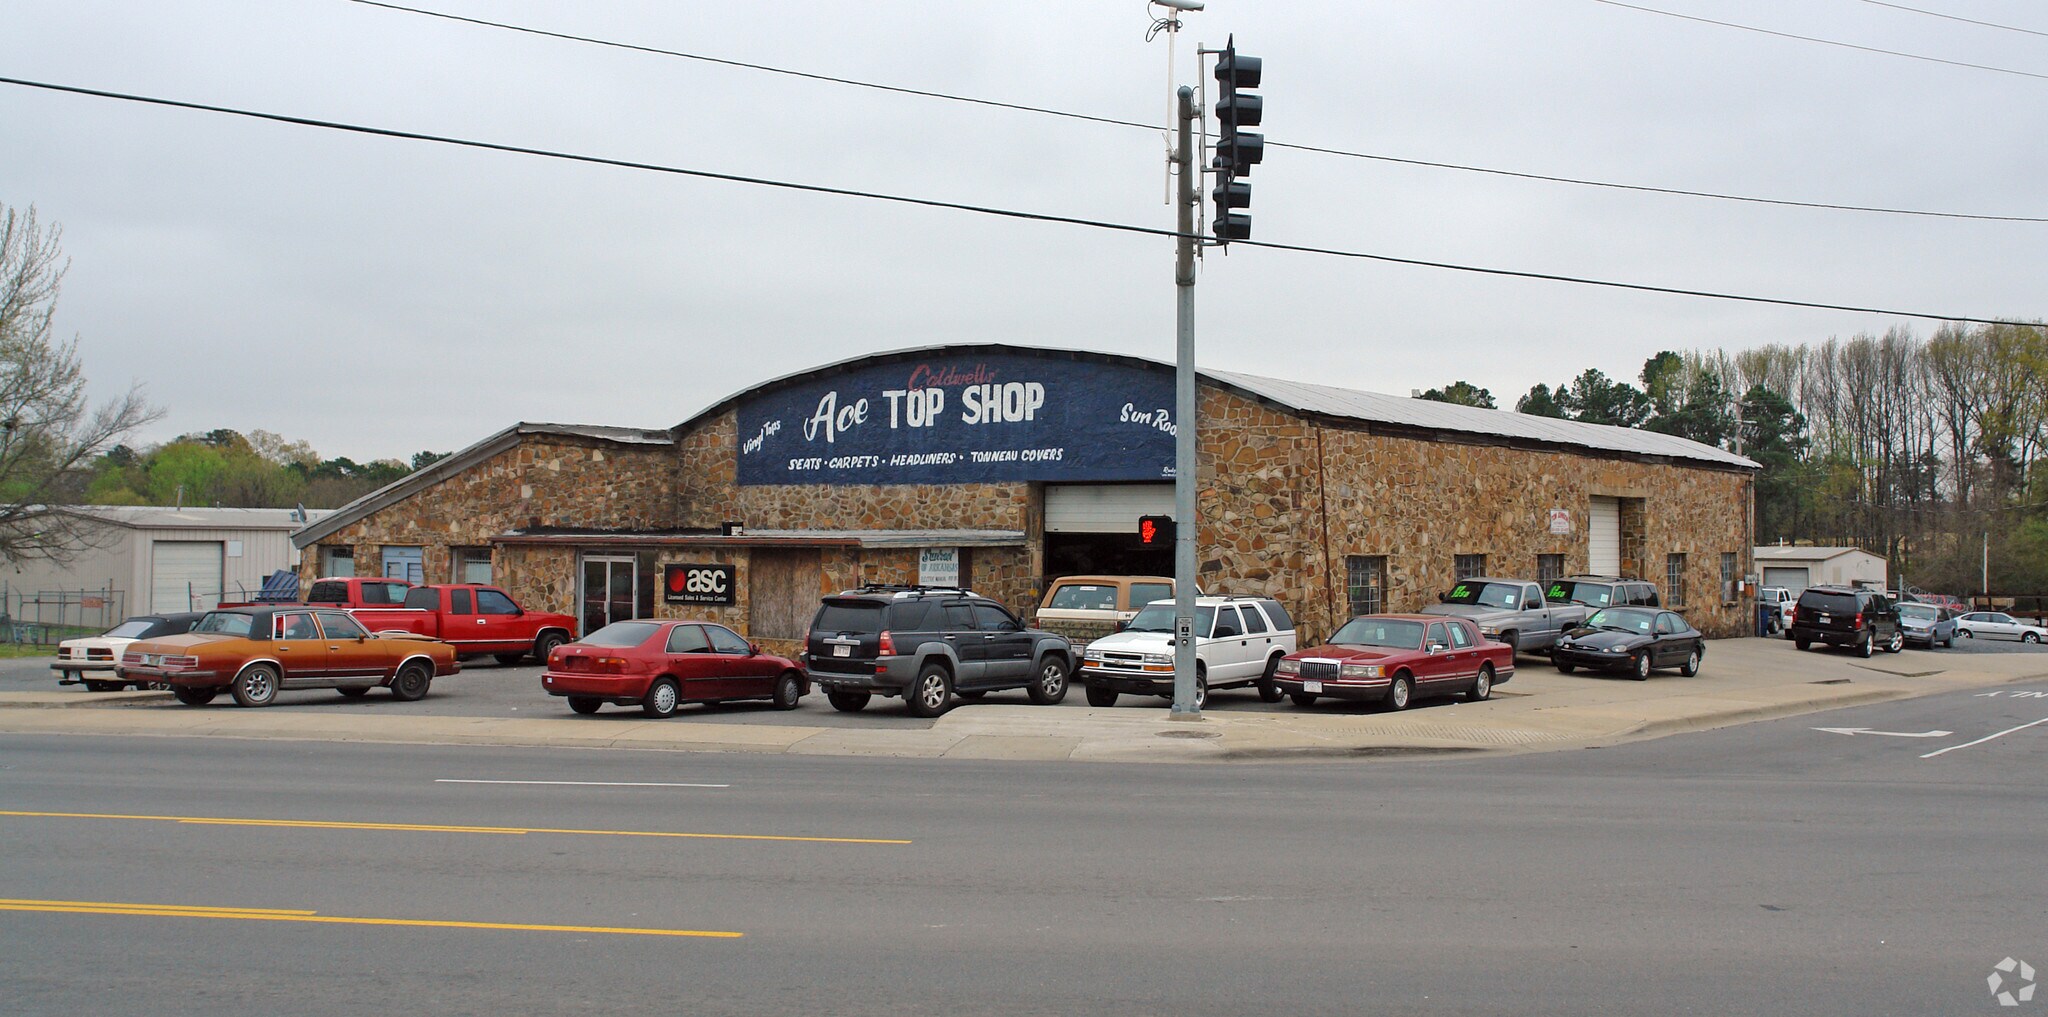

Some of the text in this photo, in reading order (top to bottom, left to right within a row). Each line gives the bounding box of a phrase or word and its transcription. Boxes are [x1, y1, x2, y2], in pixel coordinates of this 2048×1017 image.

[804, 382, 1045, 443] Ace TOP SHOP
[1120, 402, 1177, 438] Sun Roo
[743, 420, 781, 455] Vinyl Tops
[788, 447, 1064, 471] SEATS CARPETS HEADLINERS TONNEAU COVERS
[687, 569, 726, 593] asc
